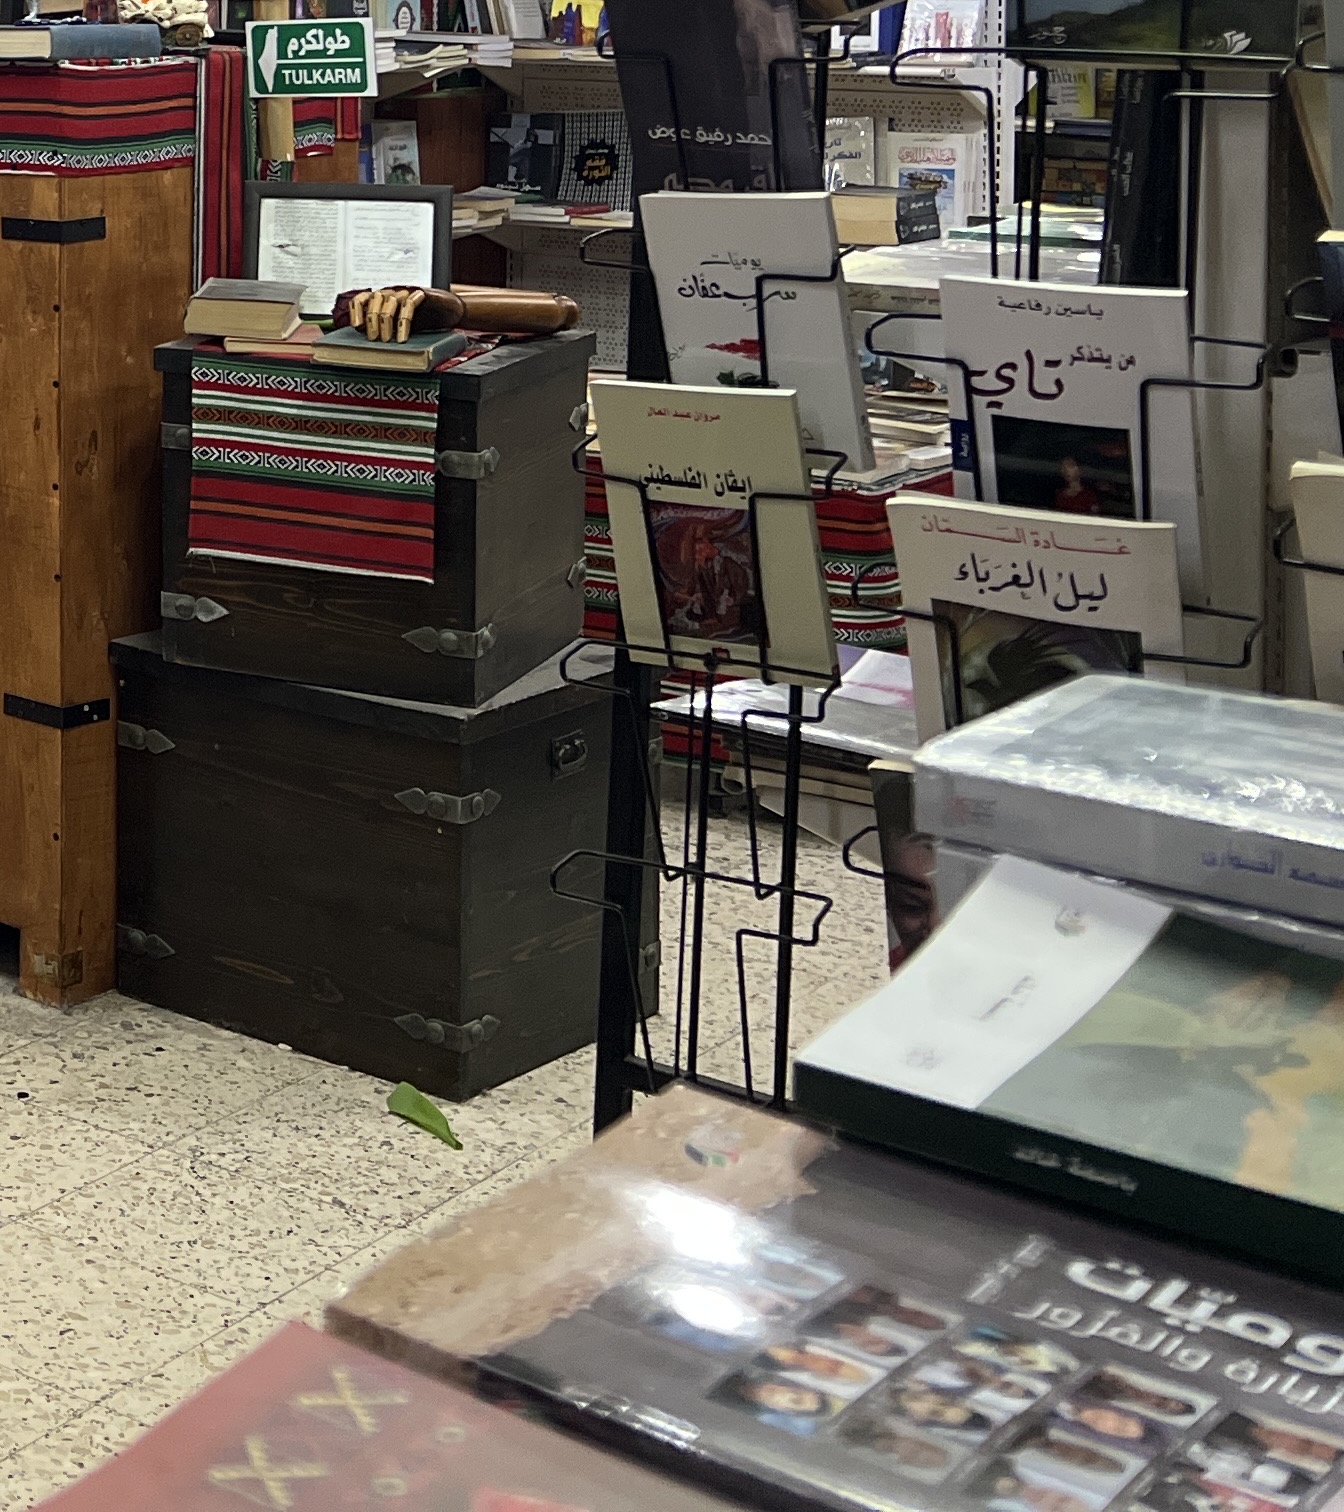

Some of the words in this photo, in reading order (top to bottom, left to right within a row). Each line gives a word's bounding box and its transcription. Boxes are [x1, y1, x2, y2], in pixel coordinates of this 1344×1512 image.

[287, 28, 350, 58] طولكرم
[282, 68, 361, 86] TULKARM
[696, 126, 732, 145] رفيق
[997, 296, 1052, 315] رفاعية
[1055, 302, 1104, 319] ياسين
[1069, 345, 1113, 369] يتذكر
[1119, 353, 1137, 371] من
[694, 411, 721, 423] مروان
[638, 463, 707, 490] الفلسطيني
